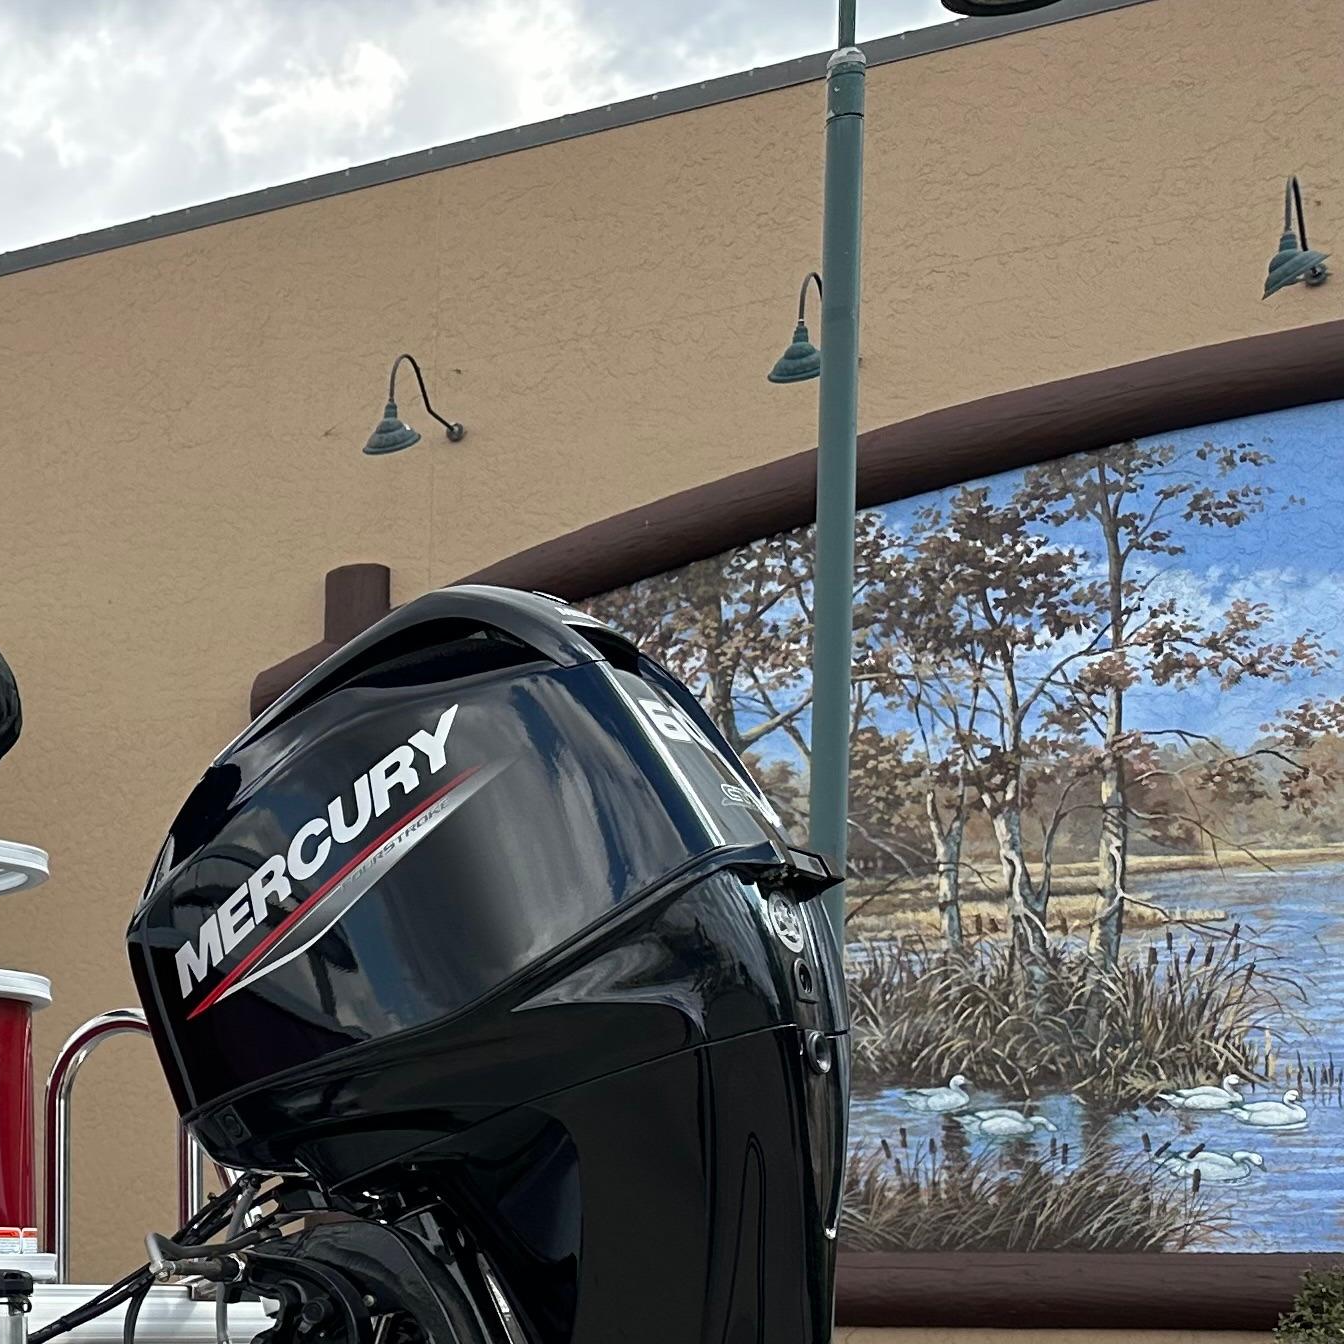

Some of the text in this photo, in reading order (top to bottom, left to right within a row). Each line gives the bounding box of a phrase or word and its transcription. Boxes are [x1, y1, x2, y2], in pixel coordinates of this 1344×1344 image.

[638, 698, 714, 751] 60
[175, 703, 459, 999] MERCURY
[340, 797, 452, 893] FOURSTROKE
